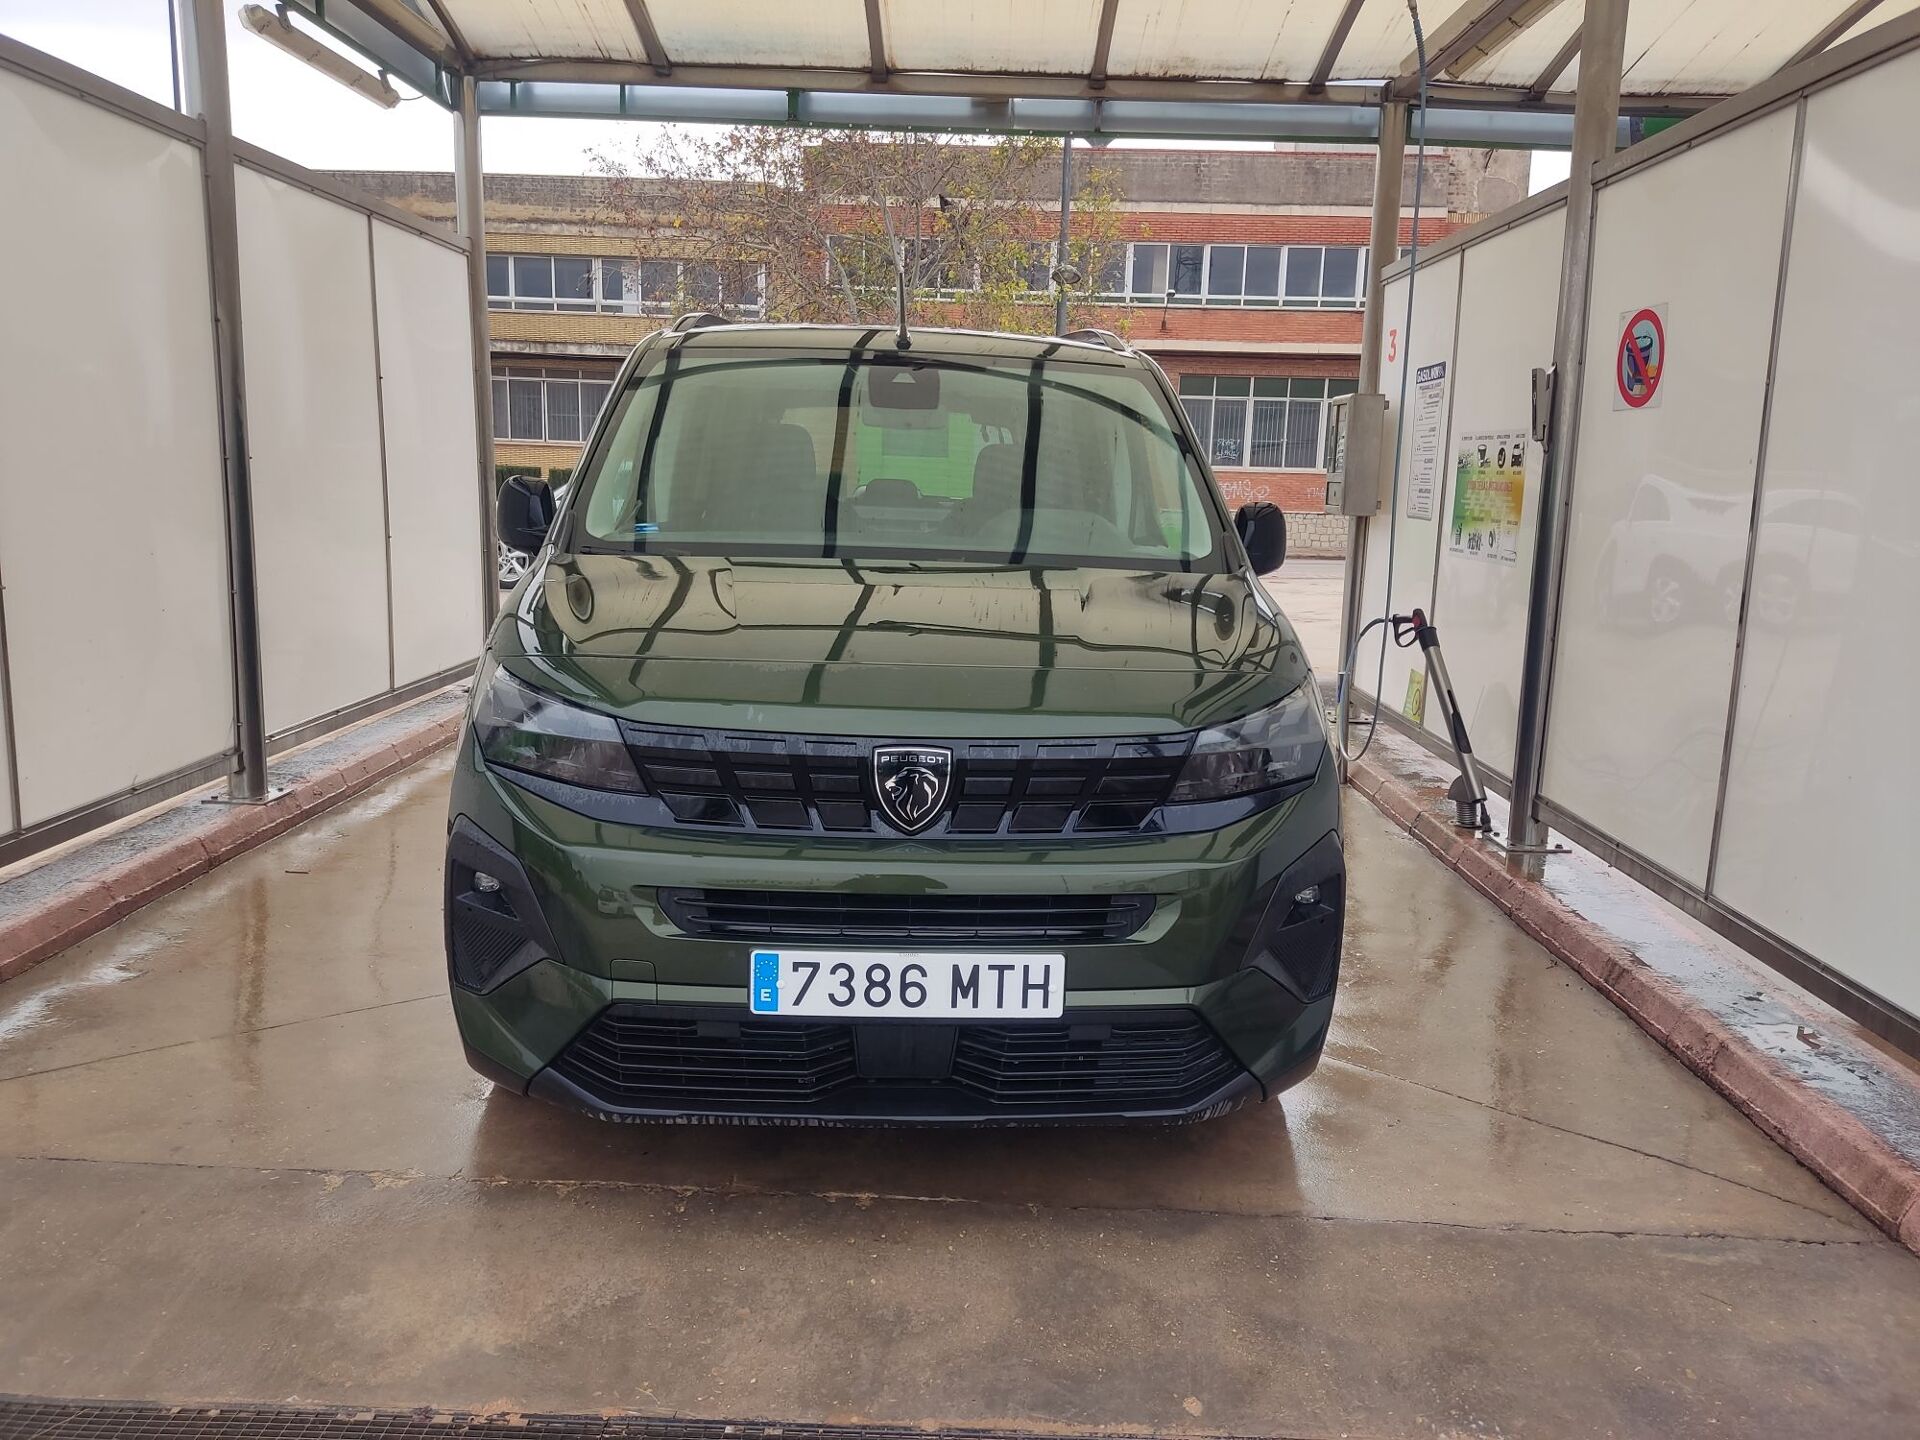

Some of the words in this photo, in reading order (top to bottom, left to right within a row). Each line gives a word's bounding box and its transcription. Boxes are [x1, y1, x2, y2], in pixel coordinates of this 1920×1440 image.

[1388, 329, 1397, 363] 3
[881, 755, 945, 764] PEUGEOT
[760, 989, 772, 1002] E
[792, 961, 928, 1008] 7386
[950, 964, 1051, 1009] MTH
